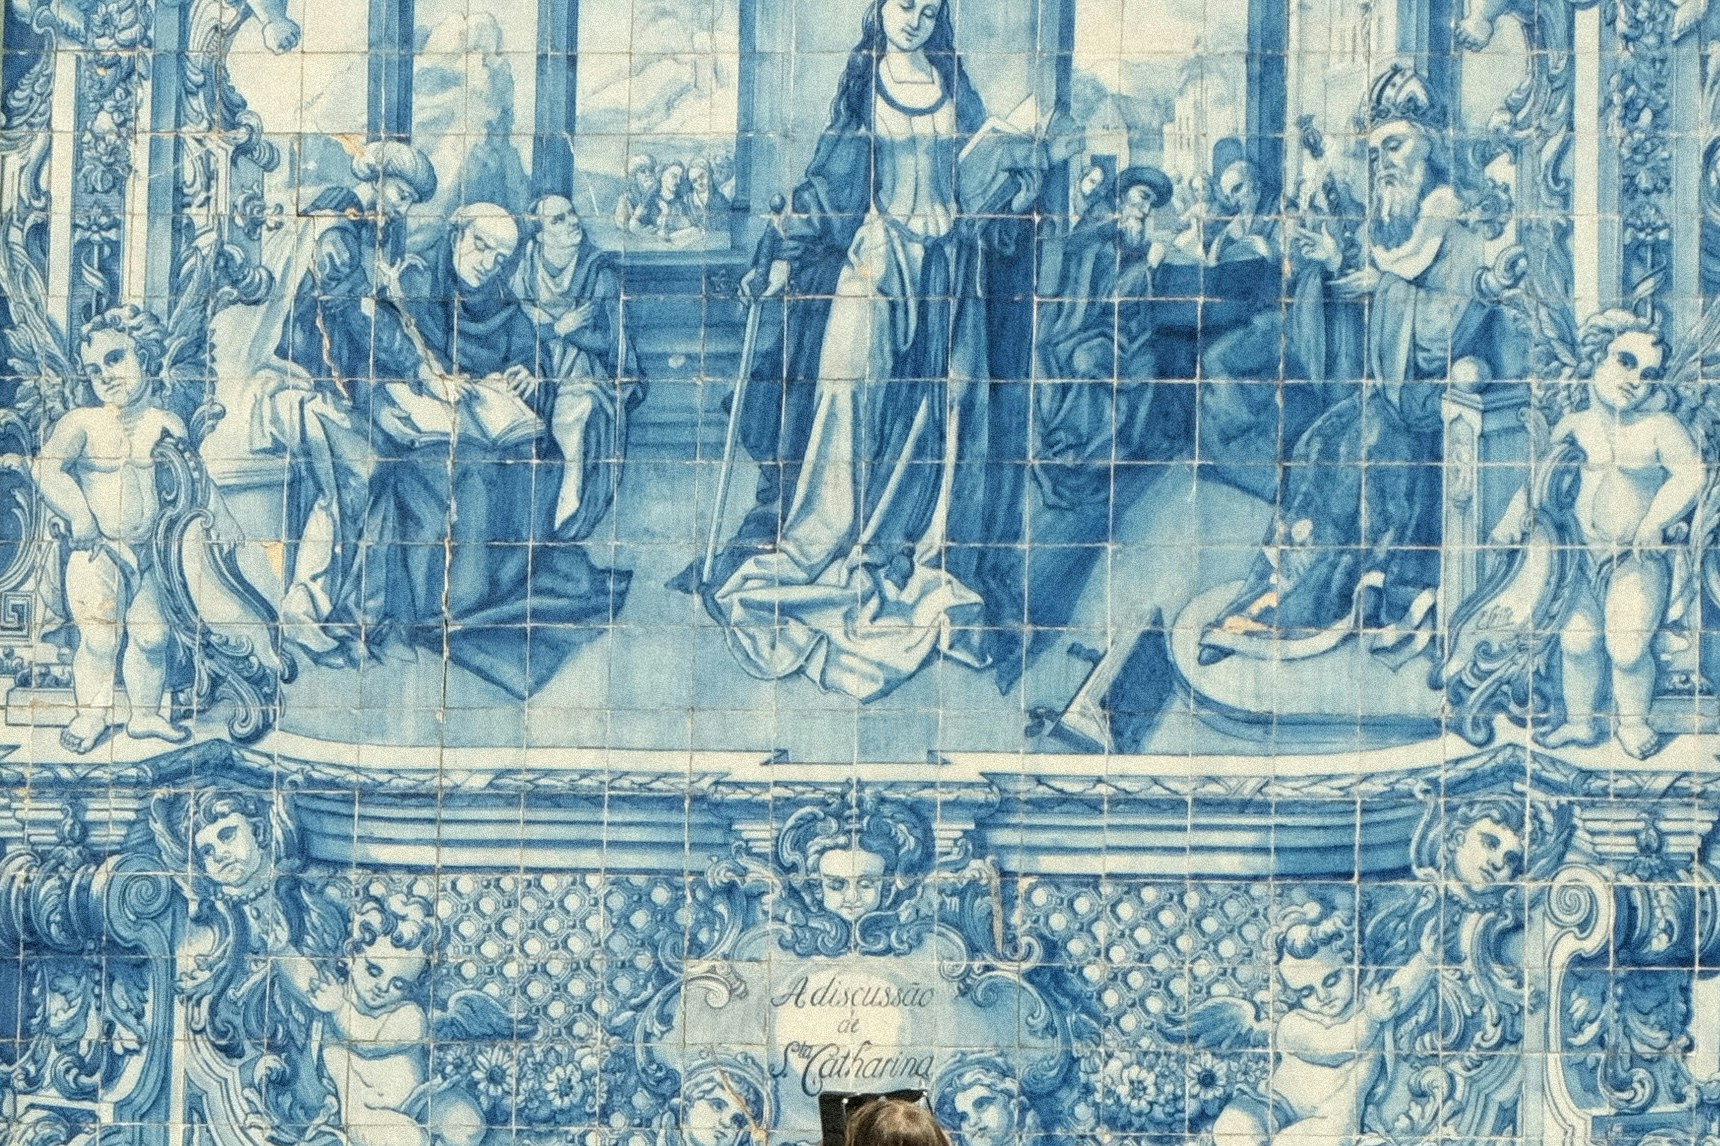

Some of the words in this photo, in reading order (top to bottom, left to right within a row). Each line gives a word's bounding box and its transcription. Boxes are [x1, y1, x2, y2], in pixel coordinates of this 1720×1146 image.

[770, 976, 809, 1009] A
[810, 976, 935, 1009] discussão
[801, 1040, 935, 1097] Catharina
